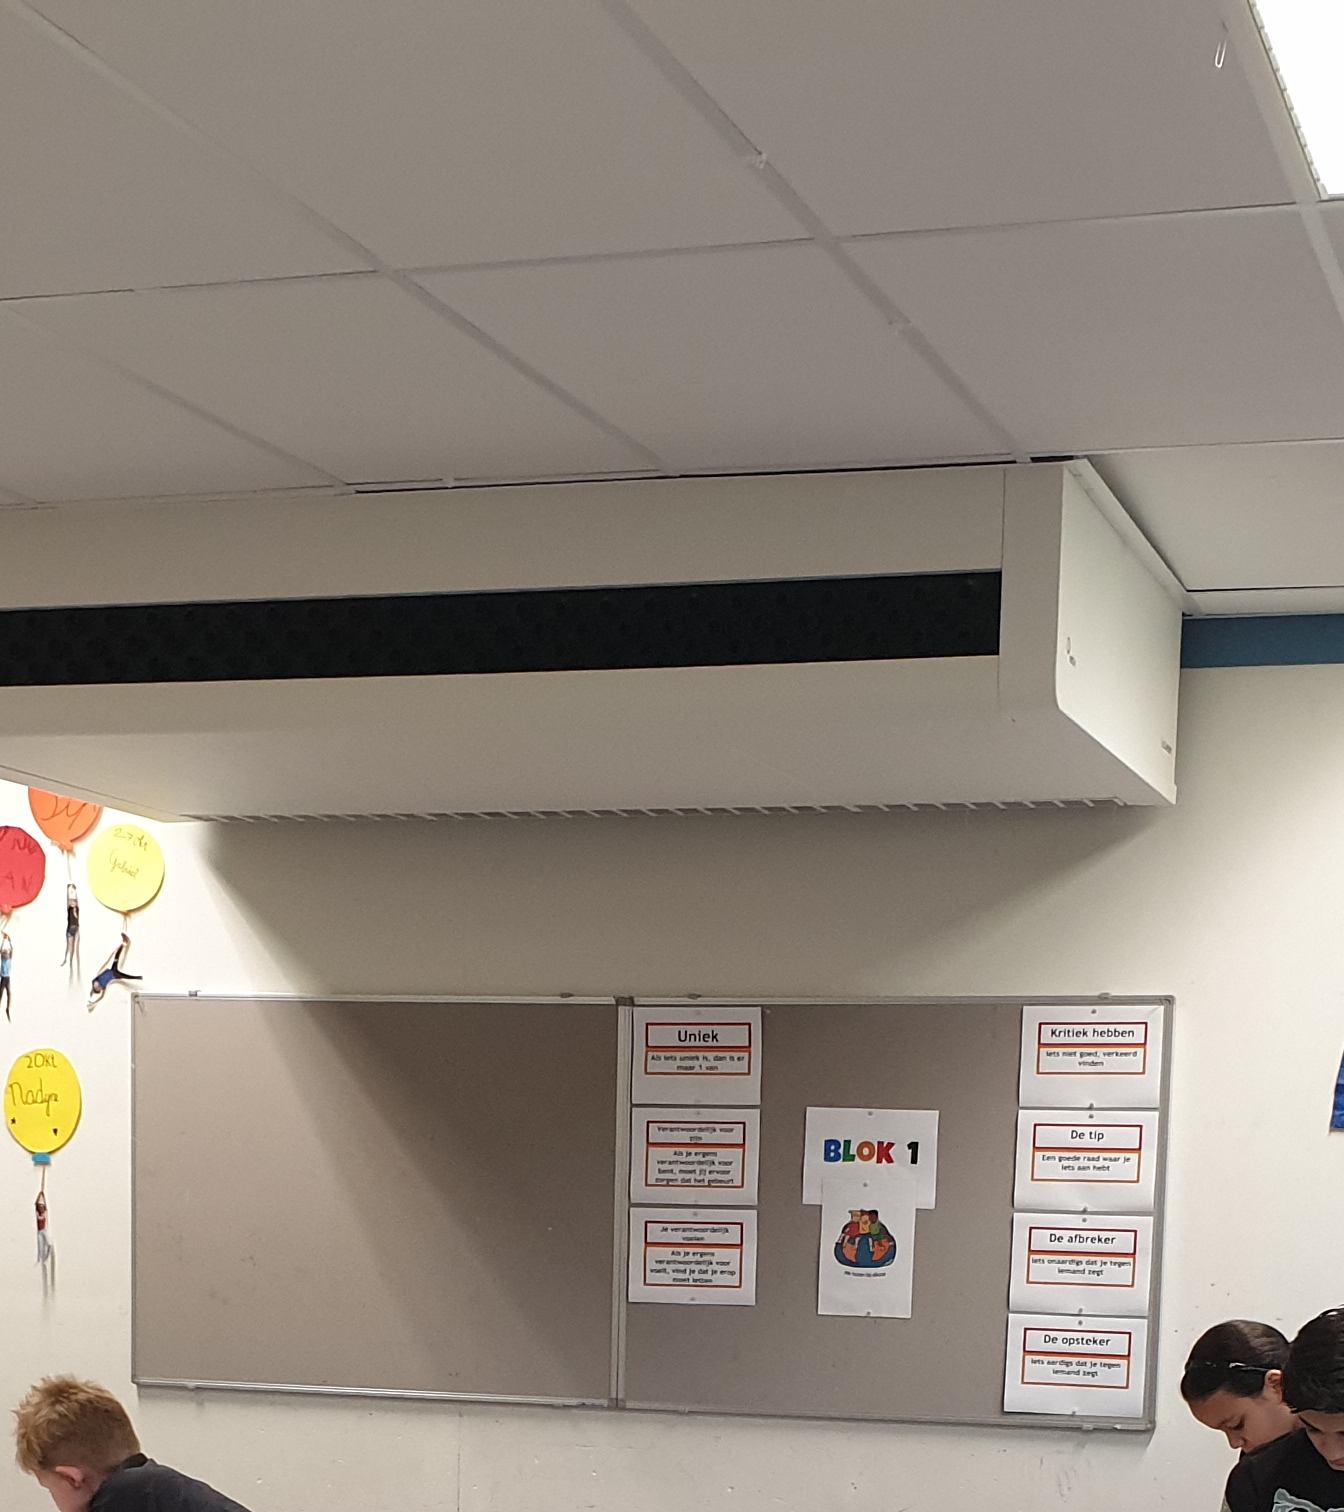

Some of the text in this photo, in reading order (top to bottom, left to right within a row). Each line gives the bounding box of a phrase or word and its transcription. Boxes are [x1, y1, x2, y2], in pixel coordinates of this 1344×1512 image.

[677, 1030, 719, 1043] Uniek
[1050, 1028, 1135, 1038] Kritiek hebben
[1070, 1129, 1105, 1141] De tip
[823, 1138, 919, 1165] BLOK 1
[1049, 1233, 1117, 1245] De afbreker
[1043, 1334, 1112, 1347] De opsteker
